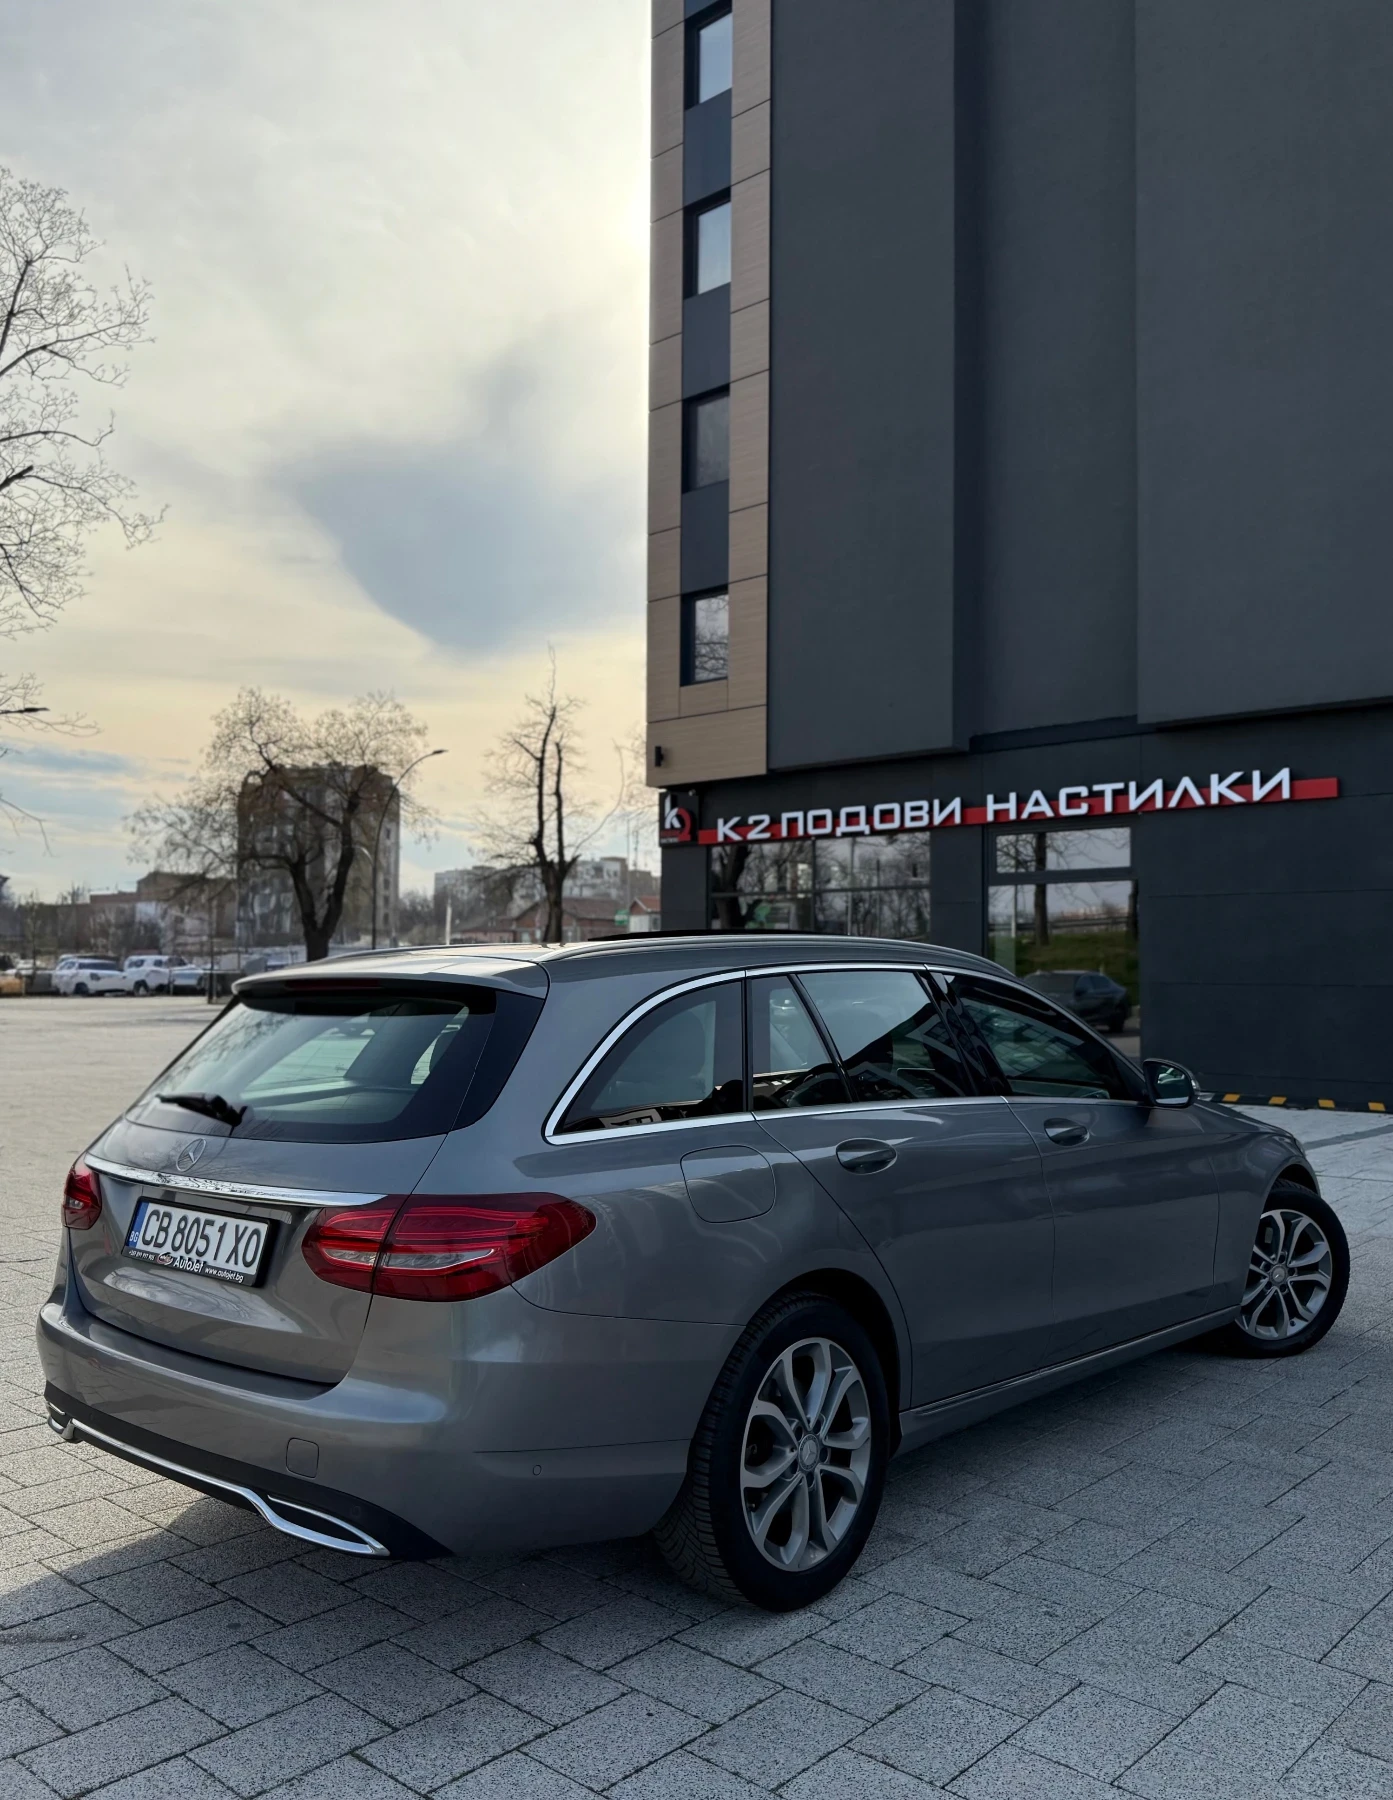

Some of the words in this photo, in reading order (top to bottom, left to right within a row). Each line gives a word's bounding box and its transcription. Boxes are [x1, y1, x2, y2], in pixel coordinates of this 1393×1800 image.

[781, 797, 962, 837] ПОДОВИ
[987, 767, 1291, 822] НАСТИЛКИ
[129, 1230, 140, 1243] BG
[142, 1209, 172, 1248] CB
[171, 1214, 227, 1261] 8051
[225, 1224, 261, 1268] XO
[173, 1256, 204, 1273] AutoJet
[204, 1267, 244, 1283] www.autojet.bg
